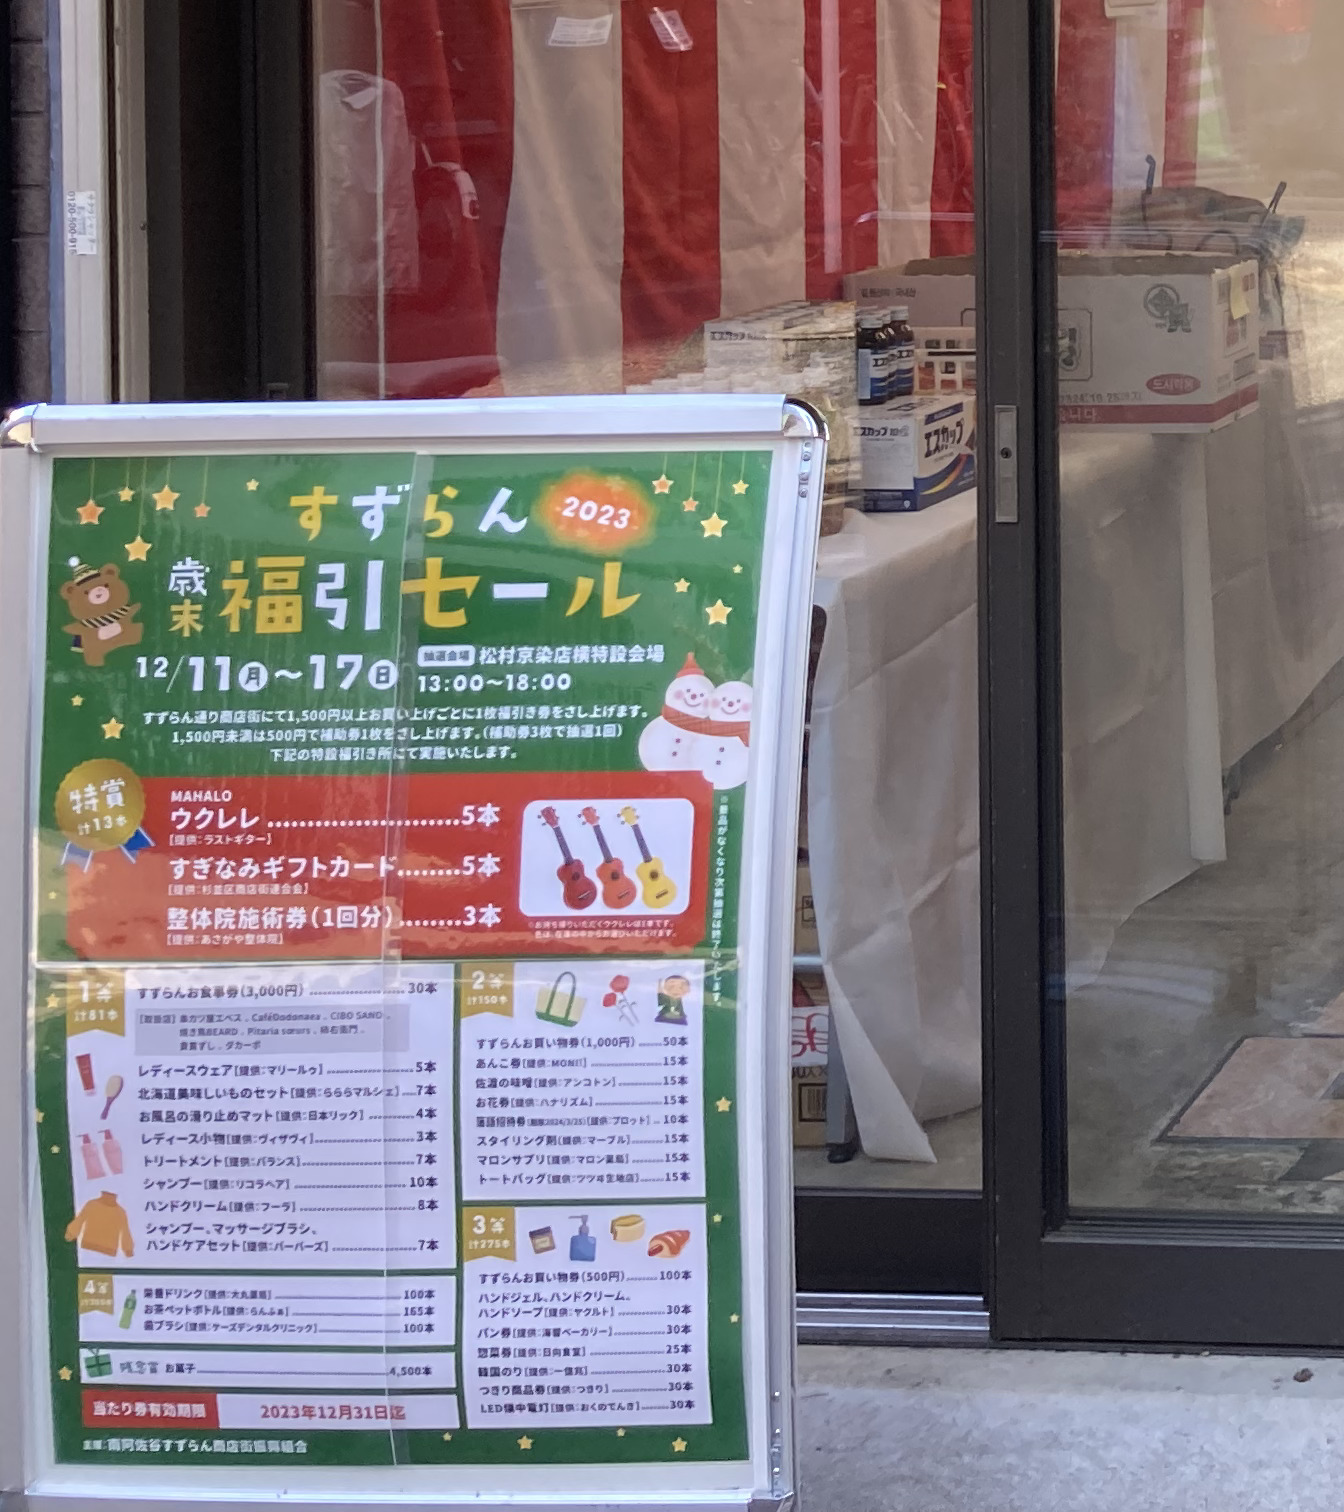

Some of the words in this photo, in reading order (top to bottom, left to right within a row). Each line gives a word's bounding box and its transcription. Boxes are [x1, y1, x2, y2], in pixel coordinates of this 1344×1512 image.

[925, 417, 964, 458] エスカップ
[290, 484, 528, 542] すずらん
[562, 496, 631, 529] 2023
[168, 556, 210, 637] 歳末
[218, 556, 641, 634] 福引セール
[479, 644, 665, 664] 松村京染店横特設会場
[69, 778, 125, 814] 特賞
[170, 790, 232, 803] MAHALO
[170, 807, 260, 830] ウクレレ
[462, 802, 501, 827] 5本
[77, 815, 128, 837] 計13本
[169, 855, 397, 880] すぎなみギフトカード
[463, 852, 501, 877] 5本
[167, 906, 392, 930] 整体院施術券(1回分)
[463, 903, 501, 928] 3本
[471, 970, 504, 990] 2等
[79, 980, 114, 1003] 1等
[408, 982, 439, 995] 30本
[467, 995, 508, 1006] 計150本
[74, 1009, 118, 1022] 計81本
[663, 1036, 688, 1047] 50本
[415, 1060, 437, 1073] 5本
[663, 1055, 688, 1066] 15本
[663, 1075, 688, 1086] 15本
[416, 1084, 437, 1096] 7本
[663, 1095, 688, 1105] 15本
[415, 1107, 437, 1119] 4本
[663, 1114, 688, 1124] 10本
[416, 1129, 437, 1143] 3本
[664, 1133, 689, 1143] 15本
[416, 1153, 437, 1165] 7本
[665, 1152, 690, 1163] 15本
[410, 1176, 438, 1188] 10本
[665, 1171, 691, 1182] 15本
[418, 1199, 438, 1211] 8本
[472, 1215, 505, 1234] 3等
[418, 1239, 439, 1251] 7本
[468, 1239, 511, 1250] 計275本
[659, 1270, 692, 1280] 100本
[84, 1279, 109, 1294] 4等
[404, 1289, 436, 1300] 100本
[404, 1306, 435, 1317] 165本
[666, 1304, 692, 1315] 30本
[403, 1323, 435, 1334] 100本
[666, 1324, 692, 1335] 30本
[665, 1344, 692, 1354] 25本
[165, 1362, 196, 1373] お菓子
[389, 1366, 432, 1377] 4,500本
[666, 1363, 692, 1373] 30本
[668, 1381, 693, 1392] 30本
[93, 1400, 206, 1418] 当たり券有効期限
[670, 1399, 695, 1410] 30本
[260, 1404, 406, 1420] 2023年12月31日迄
